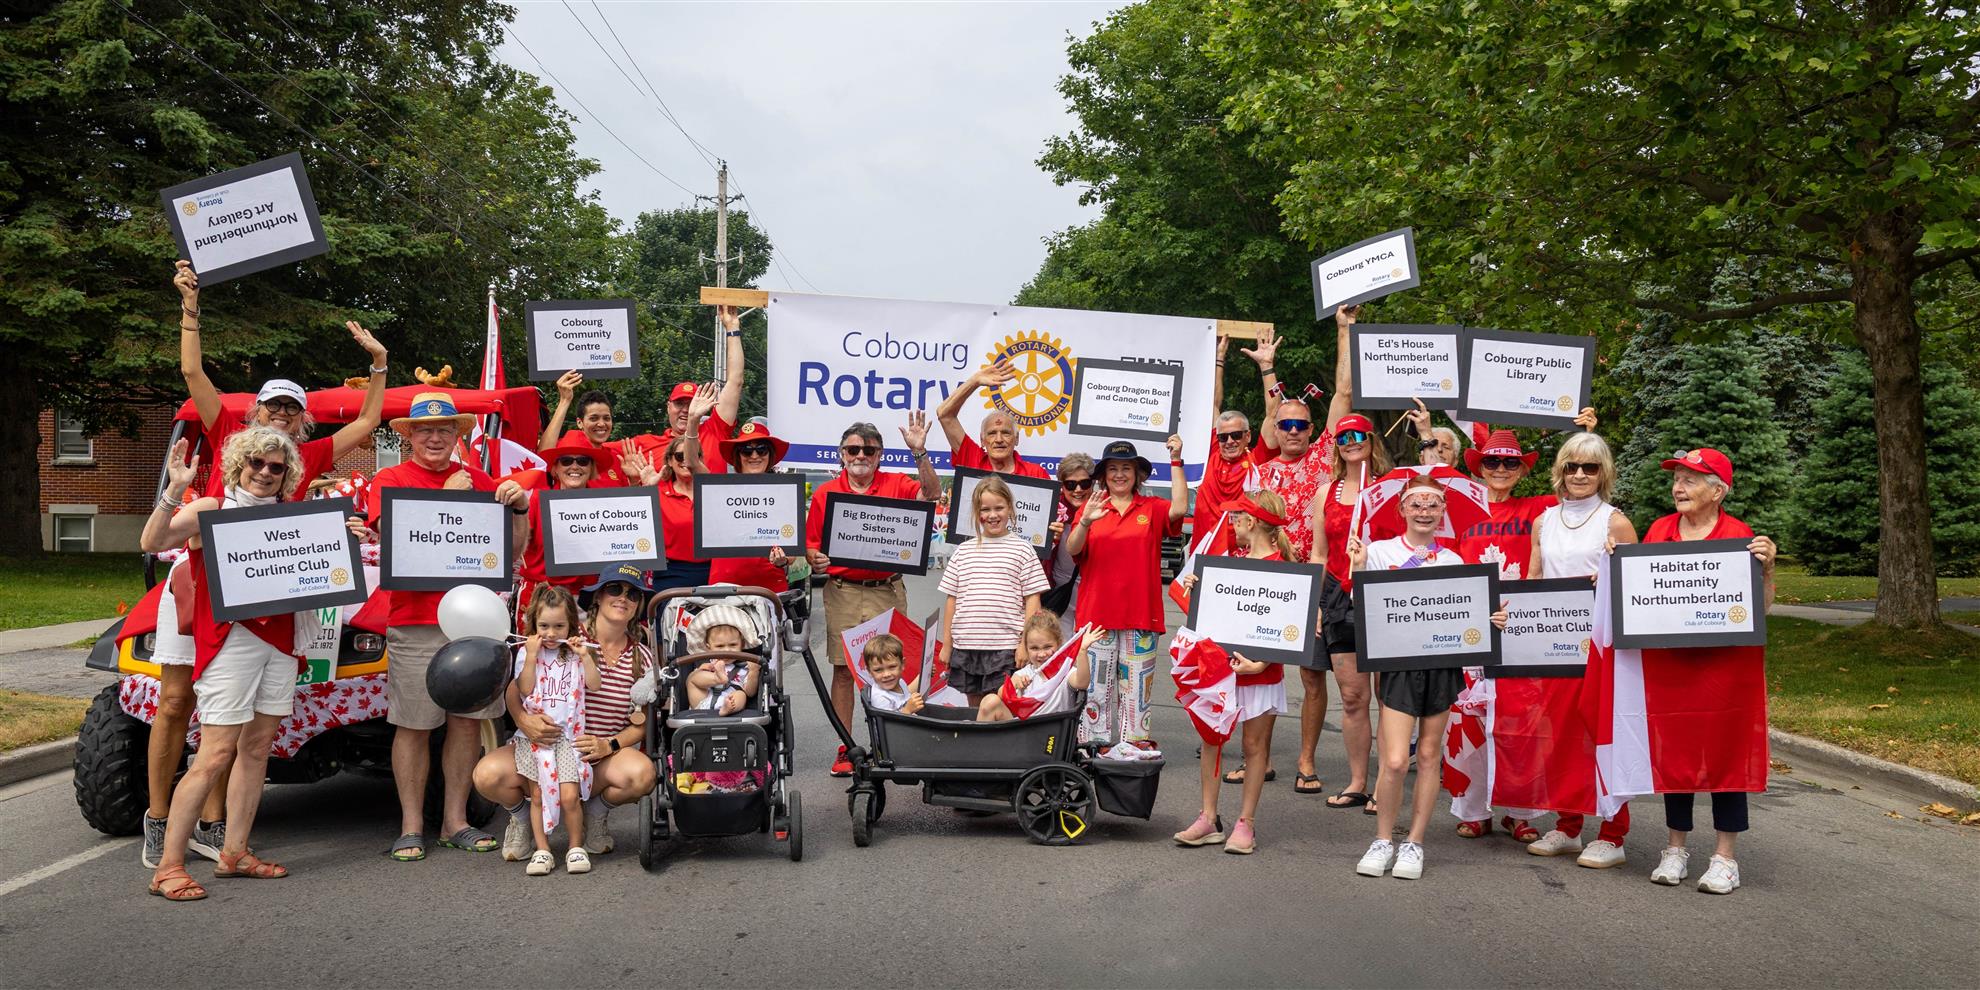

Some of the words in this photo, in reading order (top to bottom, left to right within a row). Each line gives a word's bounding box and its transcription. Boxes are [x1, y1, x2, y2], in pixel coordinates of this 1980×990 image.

[198, 198, 223, 208] Rotary
[256, 202, 274, 214] Art
[208, 208, 253, 228] Gallery
[194, 212, 298, 250] Northumberland
[1326, 261, 1364, 280] Cobourg
[1365, 251, 1395, 265] YMCA
[561, 318, 603, 327] Cobourg
[554, 330, 611, 339] Community
[567, 343, 600, 351] Centre
[1010, 342, 1054, 354] ROTARY
[1402, 340, 1434, 348] House
[842, 331, 968, 370] Cobourg
[1364, 352, 1449, 362] Northumberland
[1484, 352, 1533, 367] Cobourg
[1536, 357, 1572, 369] Public
[1386, 366, 1428, 376] Hospice
[1507, 369, 1547, 383] Library
[1087, 382, 1120, 393] Cobourg
[1122, 386, 1150, 395] Dragon
[1152, 388, 1170, 397] Boat
[1112, 395, 1138, 403] Canoe
[1140, 397, 1159, 405] Club
[1530, 397, 1555, 406] Rotary
[1128, 413, 1149, 421] Rotary
[726, 497, 760, 506] COVID
[763, 497, 775, 506] 19
[1015, 501, 1040, 512] Child
[438, 513, 462, 525] The
[558, 512, 587, 521] Town
[590, 510, 600, 519] of
[602, 510, 647, 519] Cobourg
[734, 510, 768, 519] Clinics
[843, 510, 857, 520] Big
[860, 511, 900, 523] Brothers
[903, 516, 919, 527] Big
[570, 524, 596, 534] Civic
[599, 522, 639, 532] Awards
[862, 523, 895, 534] Sisters
[264, 529, 301, 542] West
[409, 530, 442, 545] Help
[445, 531, 490, 544] Centre
[838, 532, 917, 548] Northumberland
[227, 540, 341, 564] Northumberland
[456, 556, 481, 565] Rotary
[1650, 561, 1699, 573] Habitat
[1702, 560, 1721, 570] for
[245, 564, 295, 578] Curling
[298, 559, 330, 572] Club
[618, 568, 640, 579] Rotary
[299, 575, 329, 585] Rotary
[1654, 577, 1718, 589] Humanity
[1215, 584, 1255, 596] Golden
[1258, 587, 1297, 602] Plough
[1631, 592, 1743, 606] Northumberland
[1383, 598, 1407, 608] The
[1410, 594, 1471, 606] Canadian
[1237, 601, 1270, 615] Lodge
[1508, 609, 1540, 619] rvivor
[1542, 608, 1589, 618] Thrivers
[1387, 613, 1411, 623] Fire
[1414, 610, 1470, 622] Museum
[1696, 611, 1726, 620] Rotary
[1256, 626, 1281, 637] Rotary
[1503, 626, 1534, 636] ragon
[1537, 623, 1563, 633] Boat
[1566, 622, 1592, 632] Club
[1433, 634, 1461, 642] Rotary
[1553, 643, 1579, 651] Rotary
